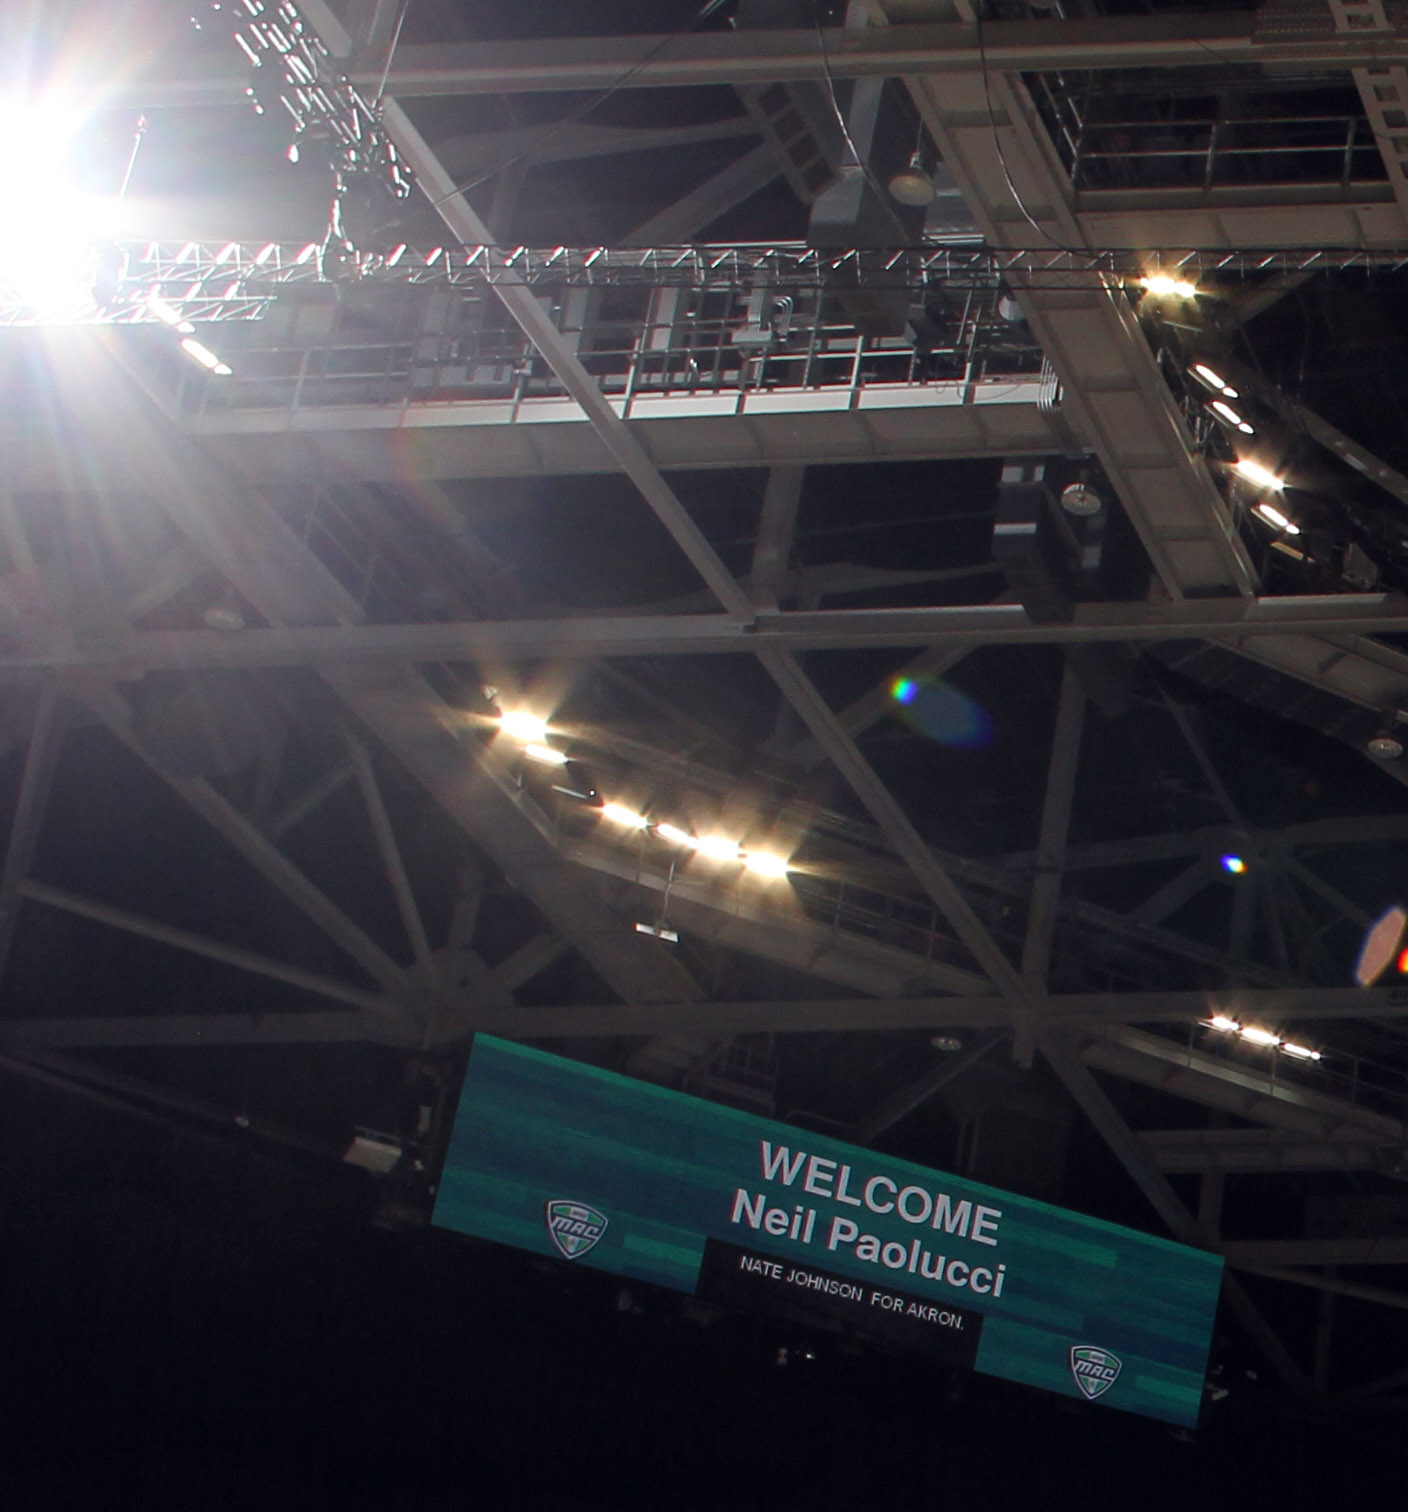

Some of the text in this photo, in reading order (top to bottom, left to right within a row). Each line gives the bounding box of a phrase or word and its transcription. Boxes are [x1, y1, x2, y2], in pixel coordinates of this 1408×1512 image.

[551, 1216, 599, 1239] MAC
[759, 1140, 1003, 1247] WELCOME
[730, 1188, 1007, 1298] Neil Paolucci
[740, 1257, 965, 1331] NATE JOHNSON FOR AKRON.
[1075, 1360, 1114, 1380] MAC
